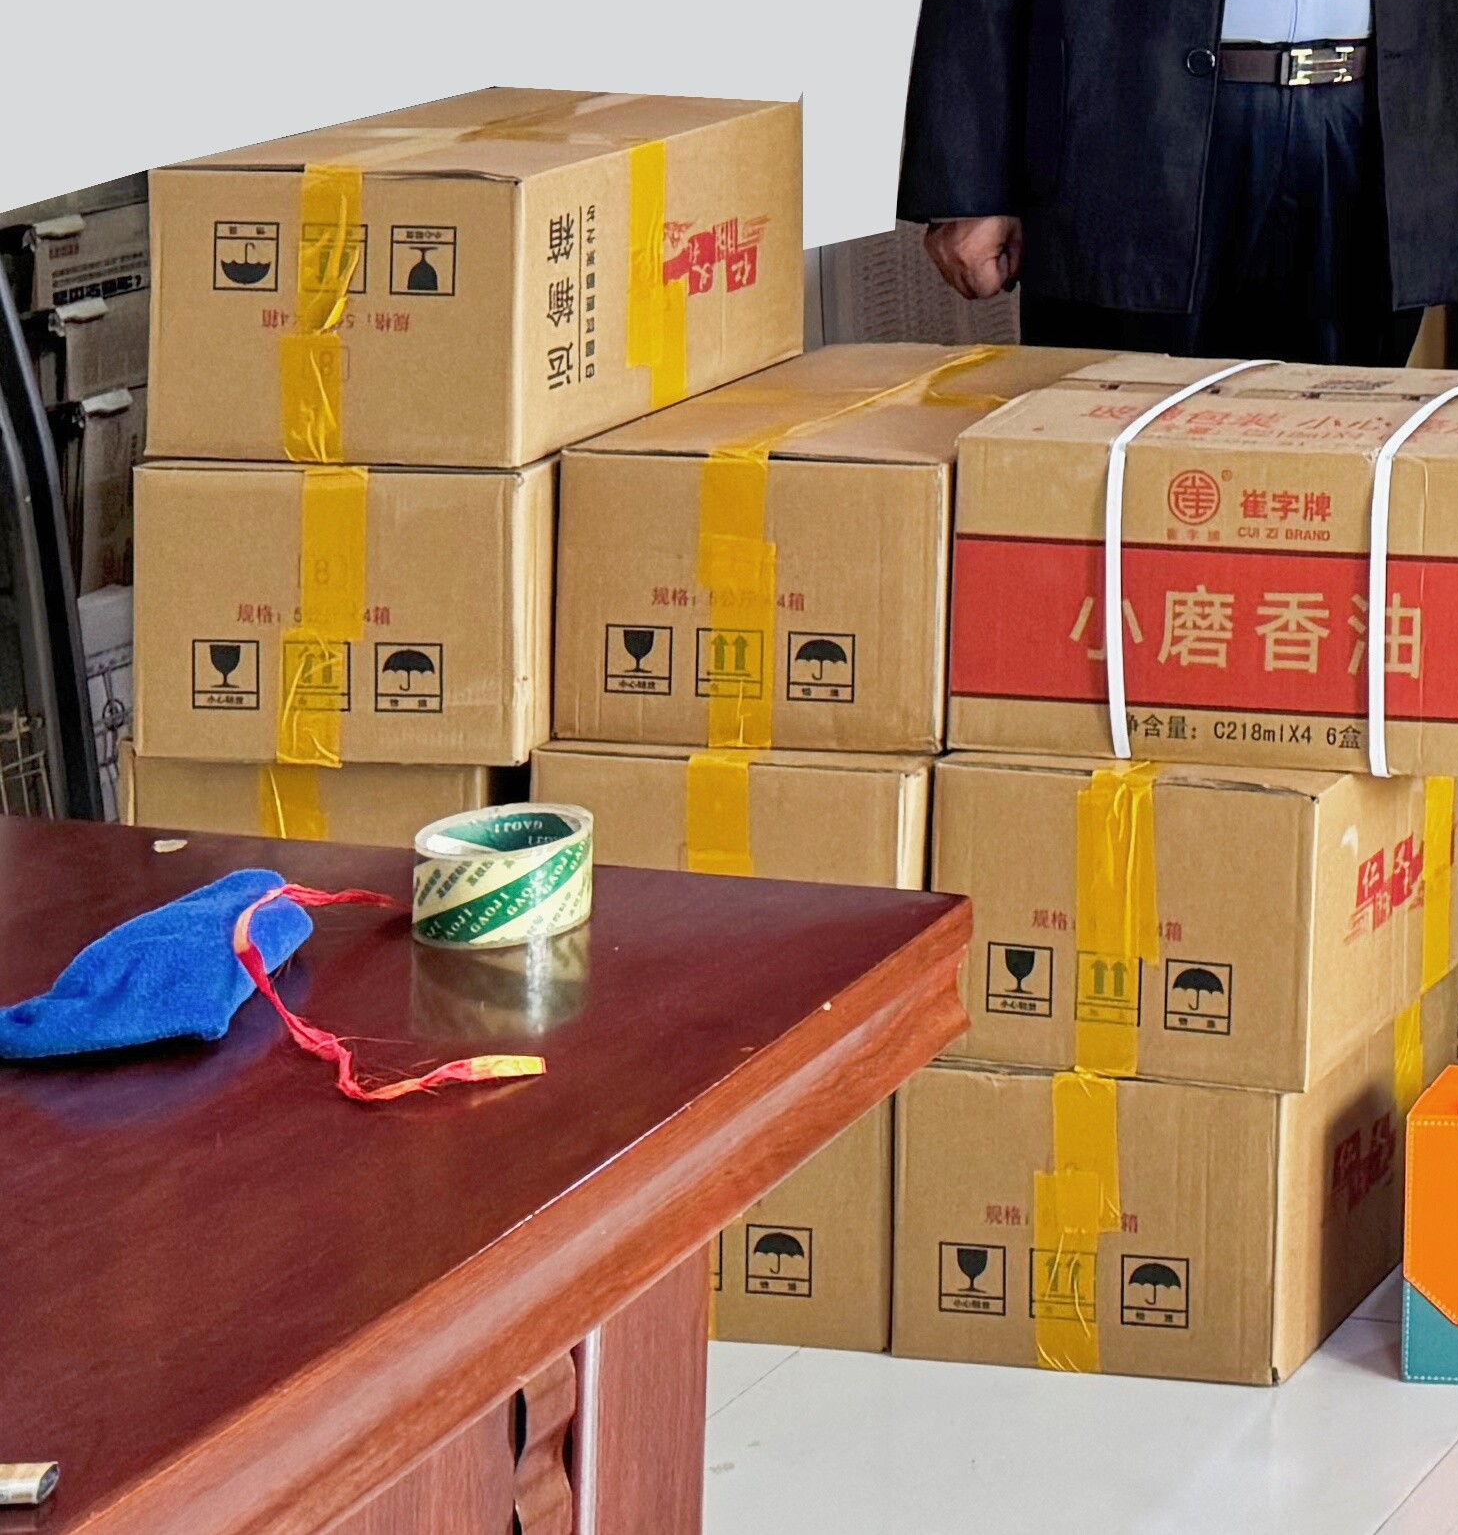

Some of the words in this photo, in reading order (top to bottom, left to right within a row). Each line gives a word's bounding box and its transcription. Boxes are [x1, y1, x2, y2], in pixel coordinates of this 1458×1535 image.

[1240, 489, 1332, 524] 崔字牌
[1238, 527, 1262, 539] CUI
[1266, 527, 1279, 539] ZI
[1285, 528, 1331, 542] BRAND
[1068, 583, 1422, 680] 小磨香油
